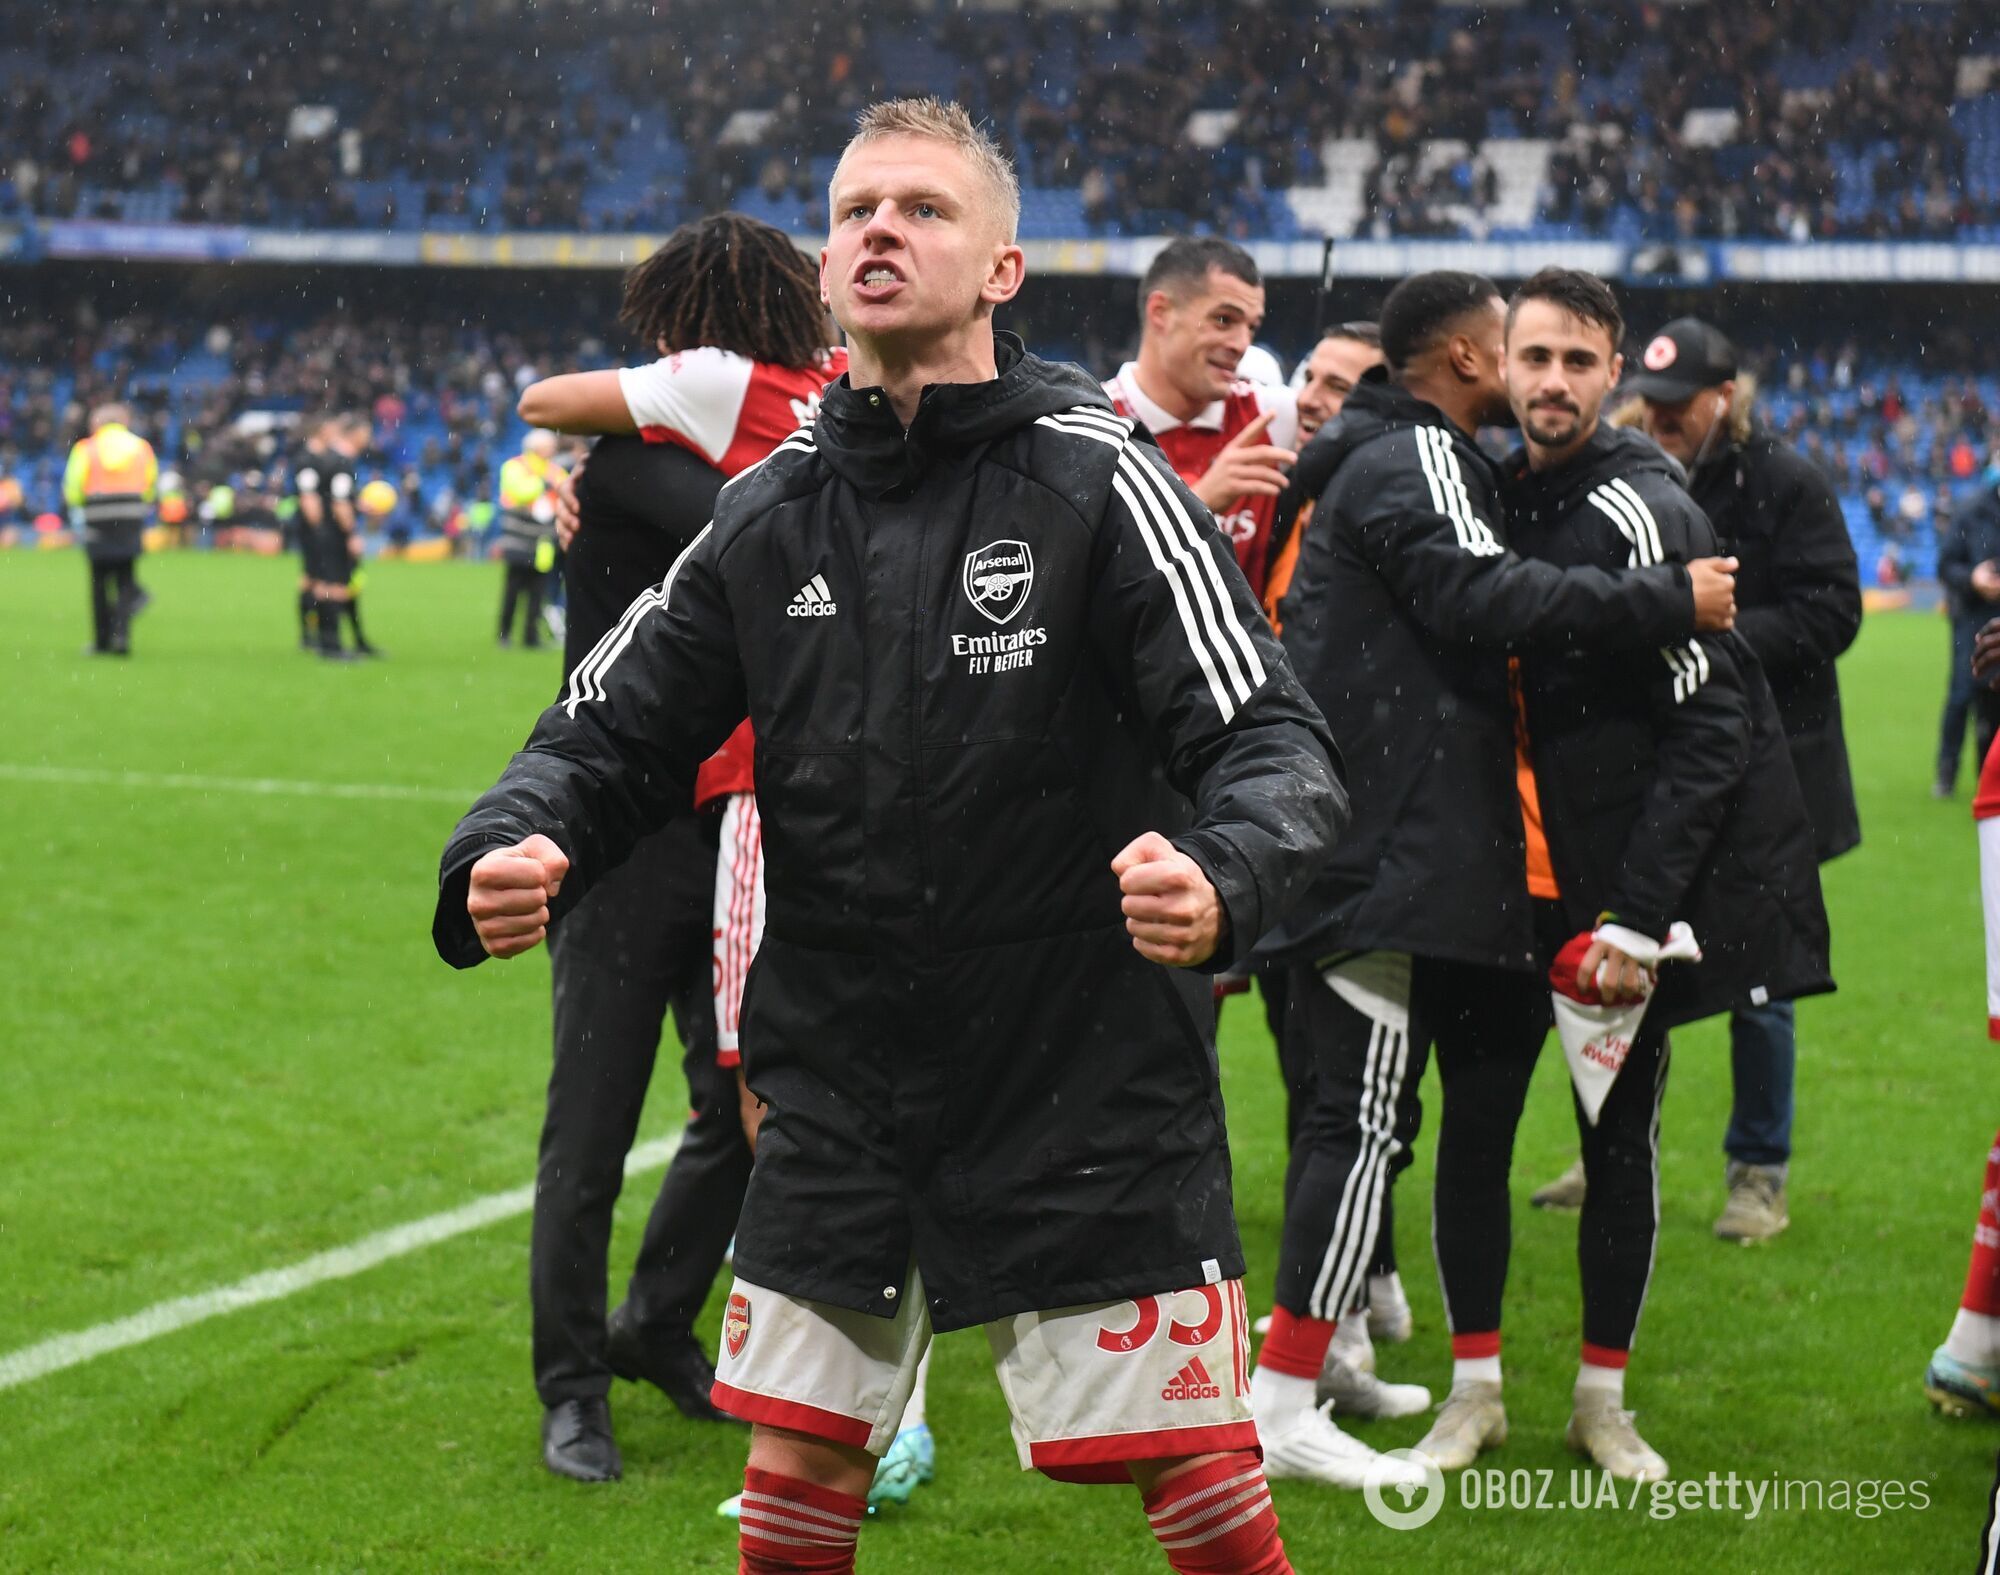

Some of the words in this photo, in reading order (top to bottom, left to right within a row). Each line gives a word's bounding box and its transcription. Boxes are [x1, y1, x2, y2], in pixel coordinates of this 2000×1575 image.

[974, 552, 1023, 573] Arsenal
[786, 601, 836, 617] adidas
[951, 627, 1047, 655] Emirates
[968, 656, 990, 675] FLY
[993, 649, 1034, 673] BETTER
[1161, 1384, 1221, 1401] adidas
